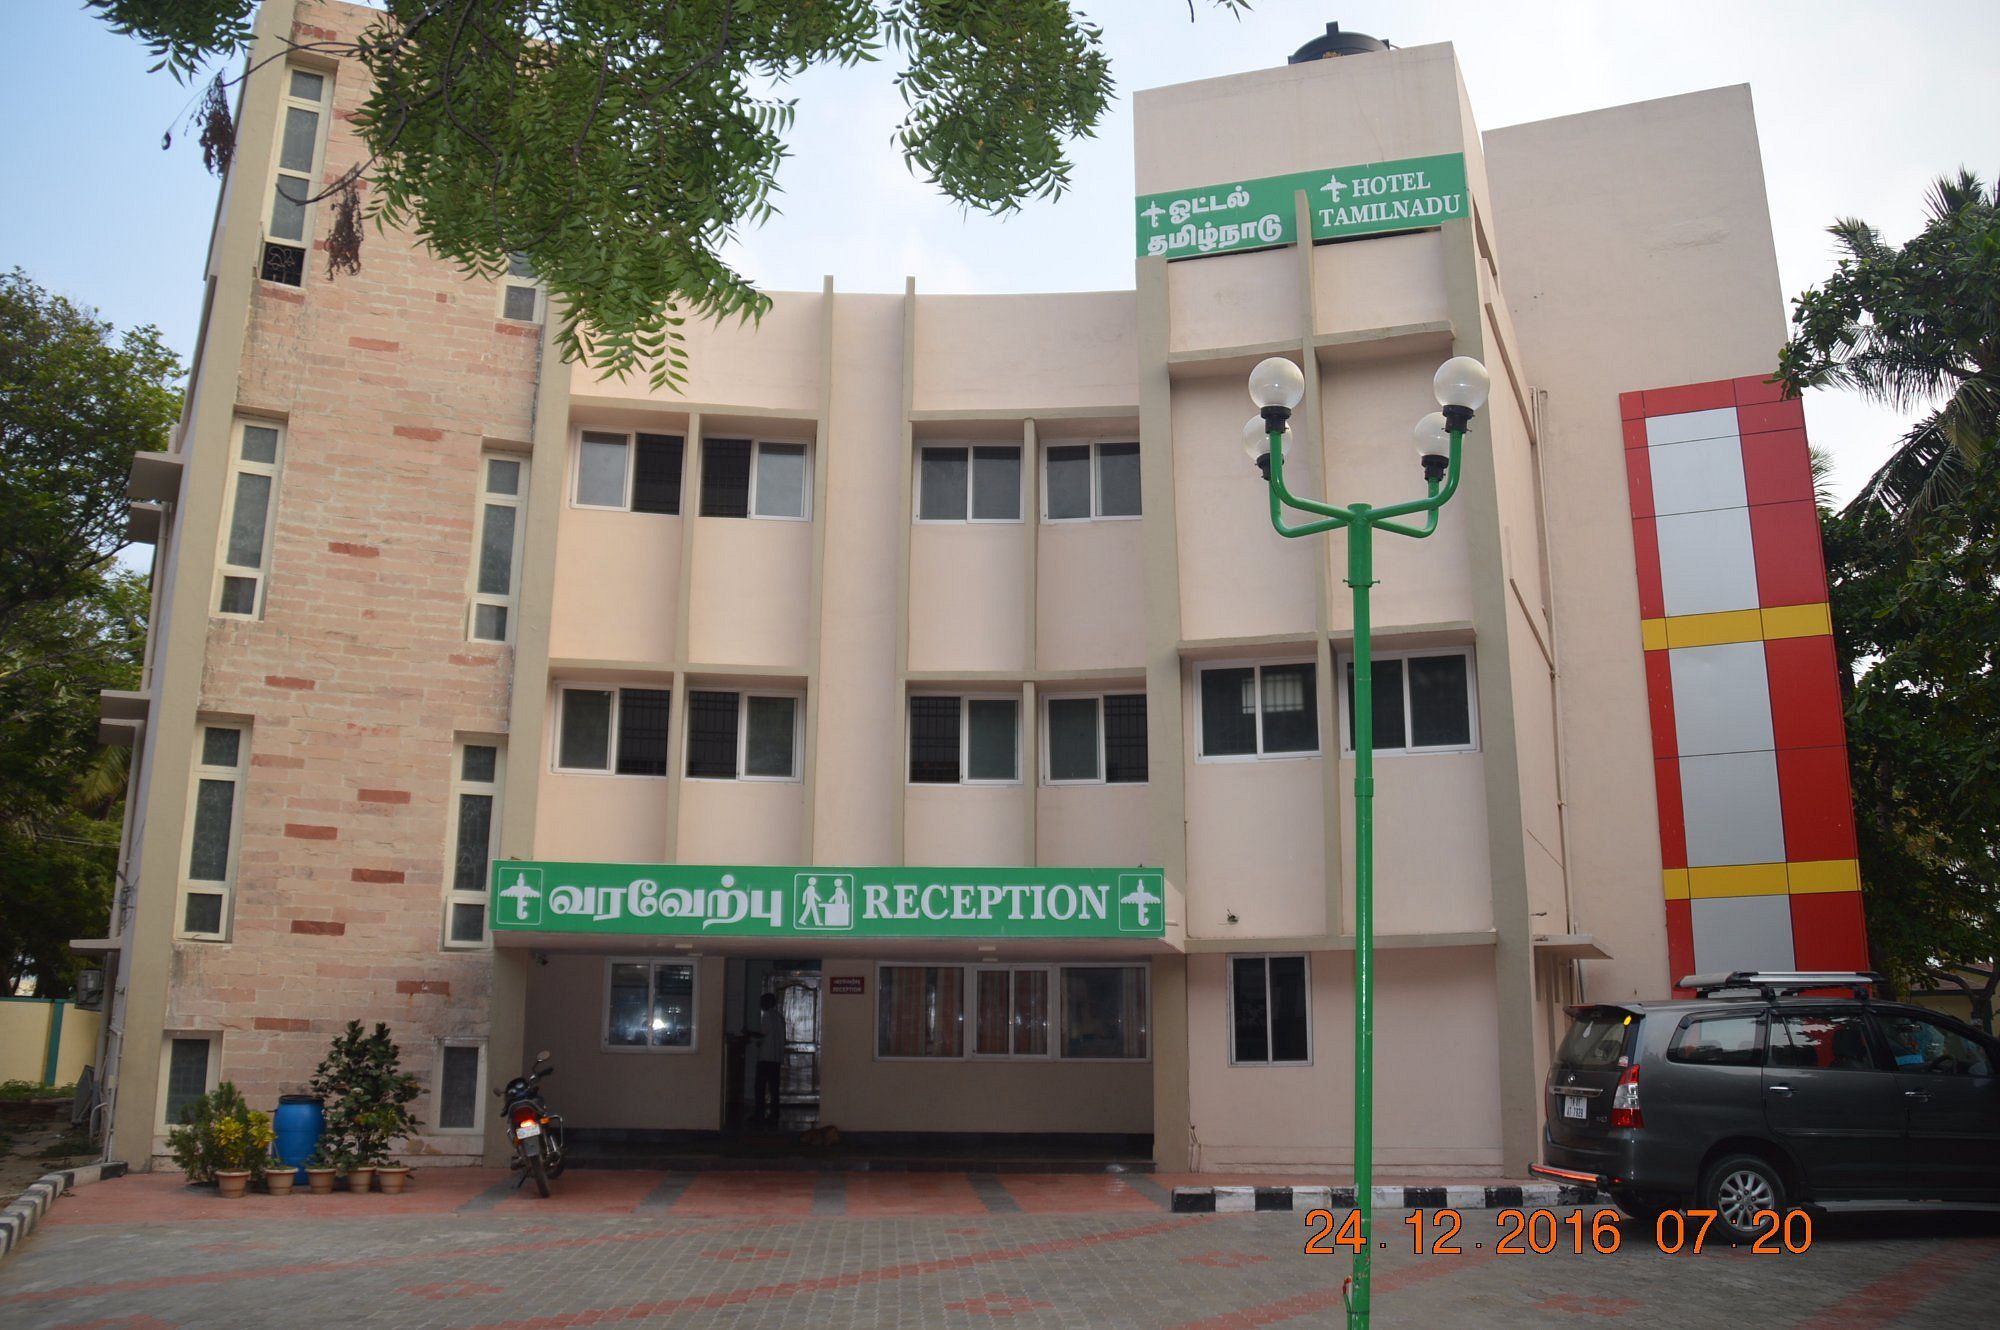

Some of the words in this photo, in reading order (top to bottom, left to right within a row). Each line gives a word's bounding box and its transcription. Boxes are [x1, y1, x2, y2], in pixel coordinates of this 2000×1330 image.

[1351, 171, 1431, 198] HOTEL
[1318, 194, 1461, 227] TAMILNADU
[1147, 213, 1282, 256] தமிழ்நாடு
[549, 874, 782, 929] வரவேற்பு
[862, 884, 1110, 920] RECEPTION
